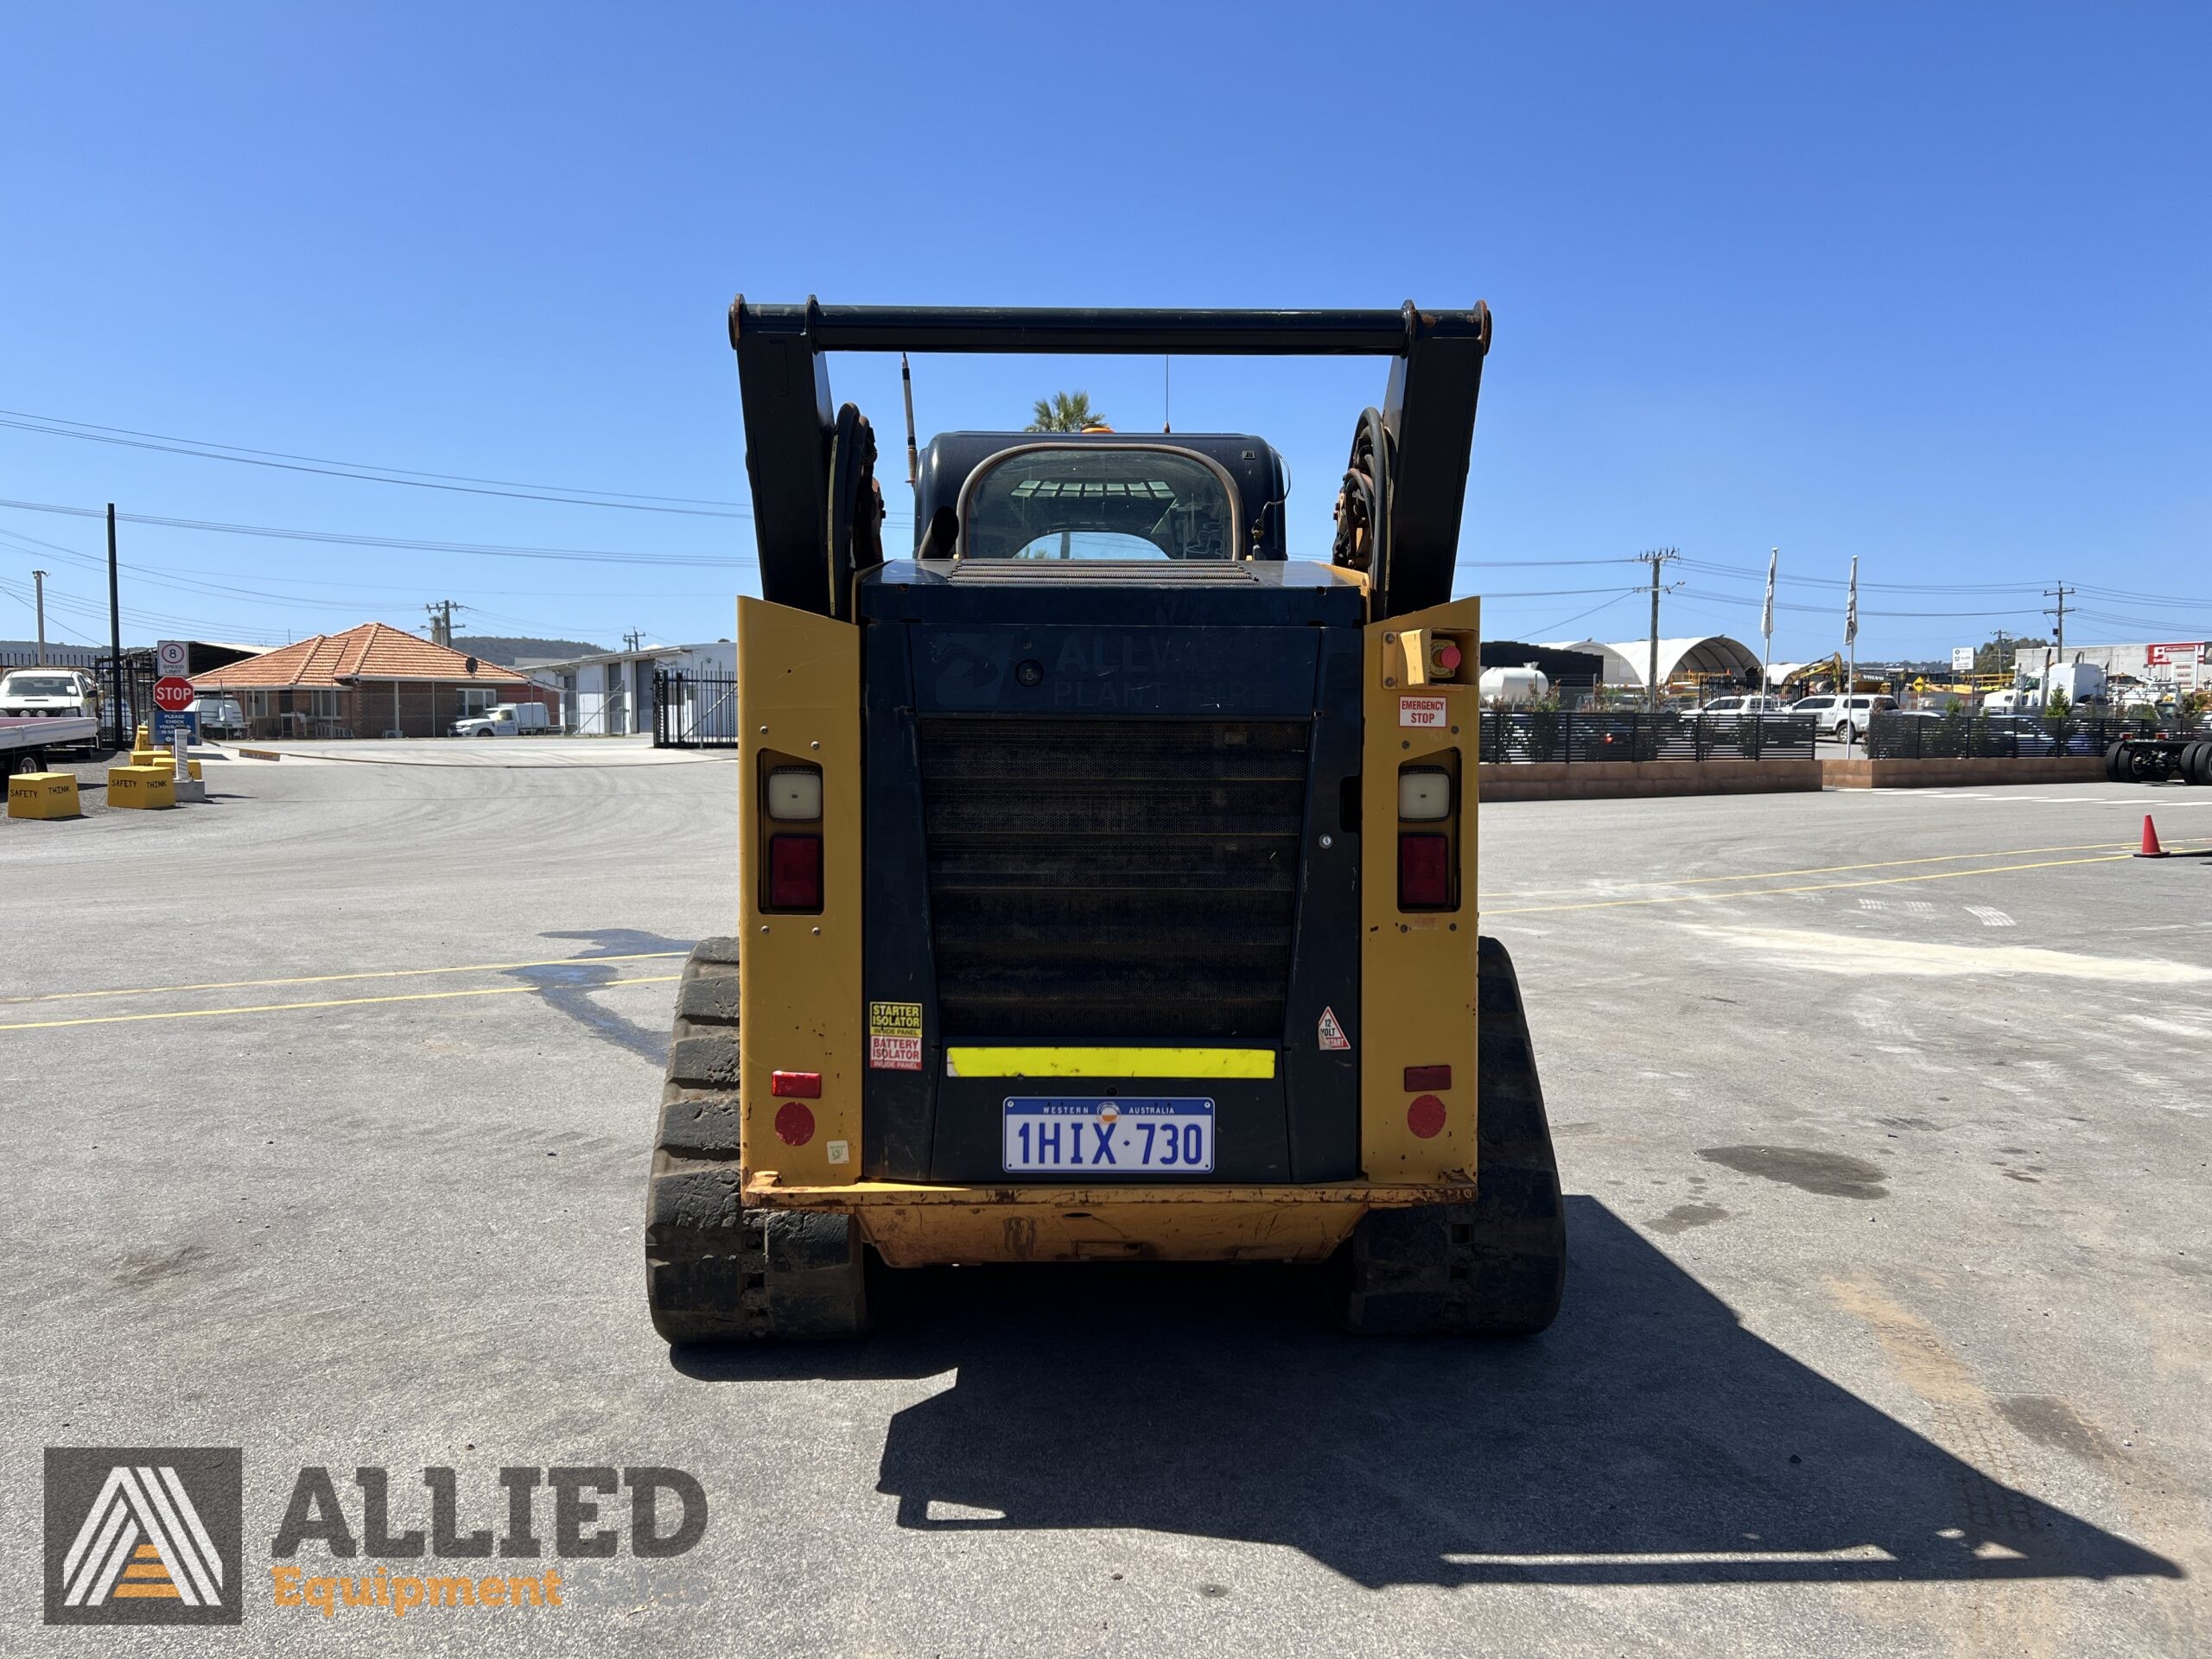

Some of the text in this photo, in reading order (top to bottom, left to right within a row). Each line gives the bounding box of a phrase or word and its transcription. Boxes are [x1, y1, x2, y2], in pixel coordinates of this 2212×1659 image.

[168, 648, 177, 659] 8
[156, 687, 192, 701] STOP
[1053, 681, 1170, 708] PLANT
[1402, 701, 1444, 710] EMERGENCY
[1411, 713, 1434, 723] STOP
[111, 779, 137, 788] SAFETY
[146, 780, 167, 789] THINK
[10, 789, 38, 798] SAFETY
[48, 785, 70, 795] THINK
[873, 1005, 919, 1017] STARTER
[872, 1015, 920, 1027] ISOLATOR
[1325, 1019, 1332, 1027] 12
[1320, 1028, 1336, 1037] VOLT
[874, 1038, 918, 1049] BATTERY
[873, 1048, 919, 1059] ISOLATOR
[1043, 1106, 1175, 1115] WESTERN AUSTRALIA
